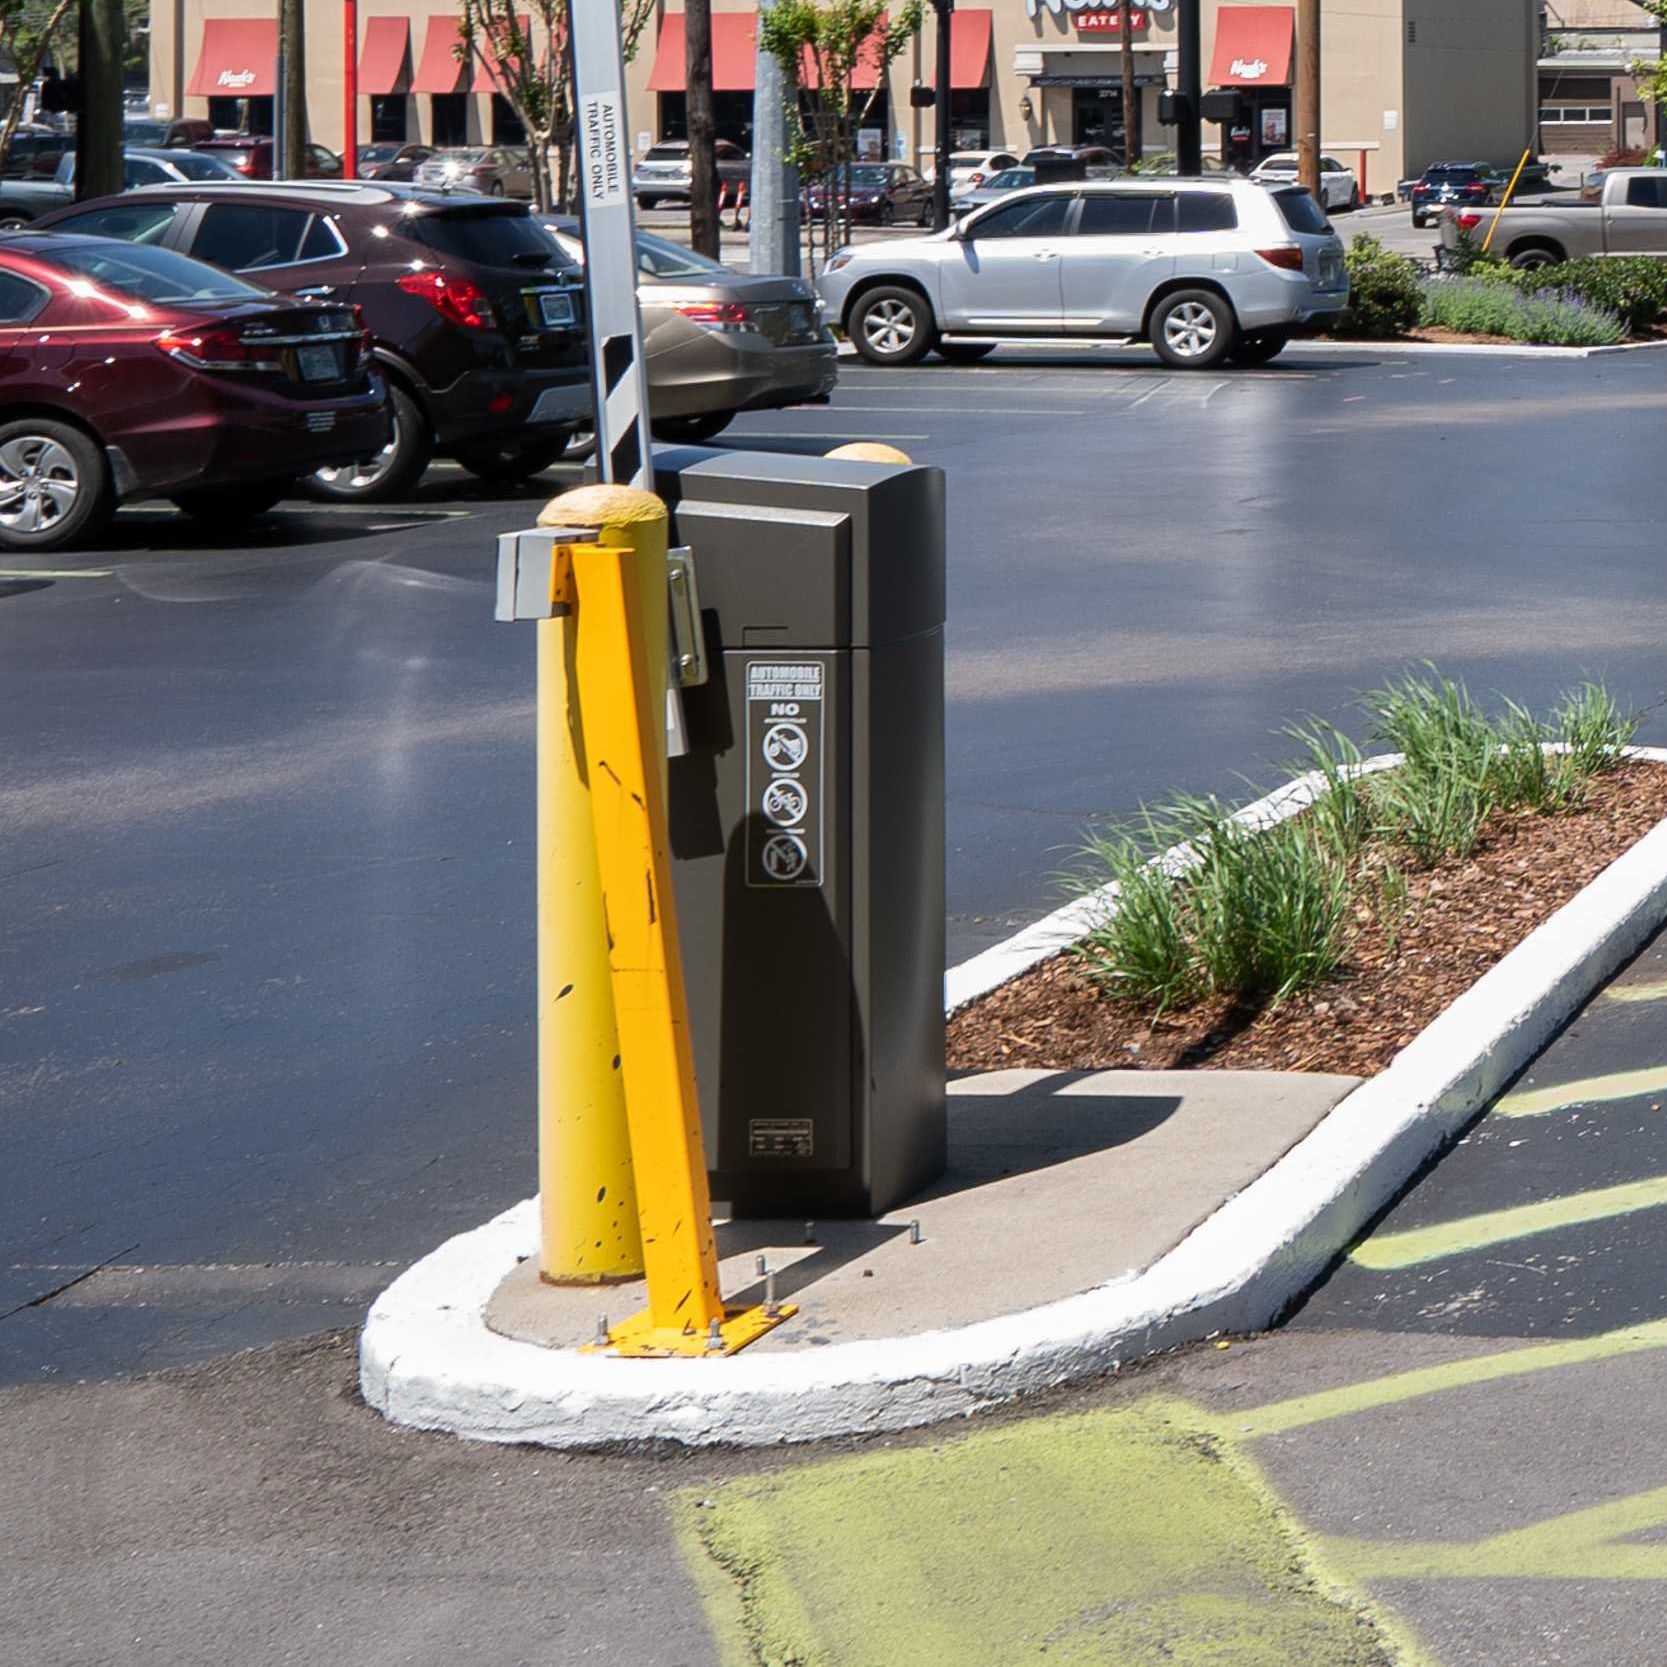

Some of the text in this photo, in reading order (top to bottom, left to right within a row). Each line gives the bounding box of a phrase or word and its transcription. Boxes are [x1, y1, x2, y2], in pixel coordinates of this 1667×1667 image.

[1078, 14, 1141, 27] EATEY
[588, 102, 605, 200] TRAFFIC ONLY
[603, 105, 618, 192] AUTOMOBILE
[750, 666, 822, 681] AUTOMOBILE
[750, 684, 822, 698] TRAFFIC ONLY
[771, 703, 800, 716] NO
